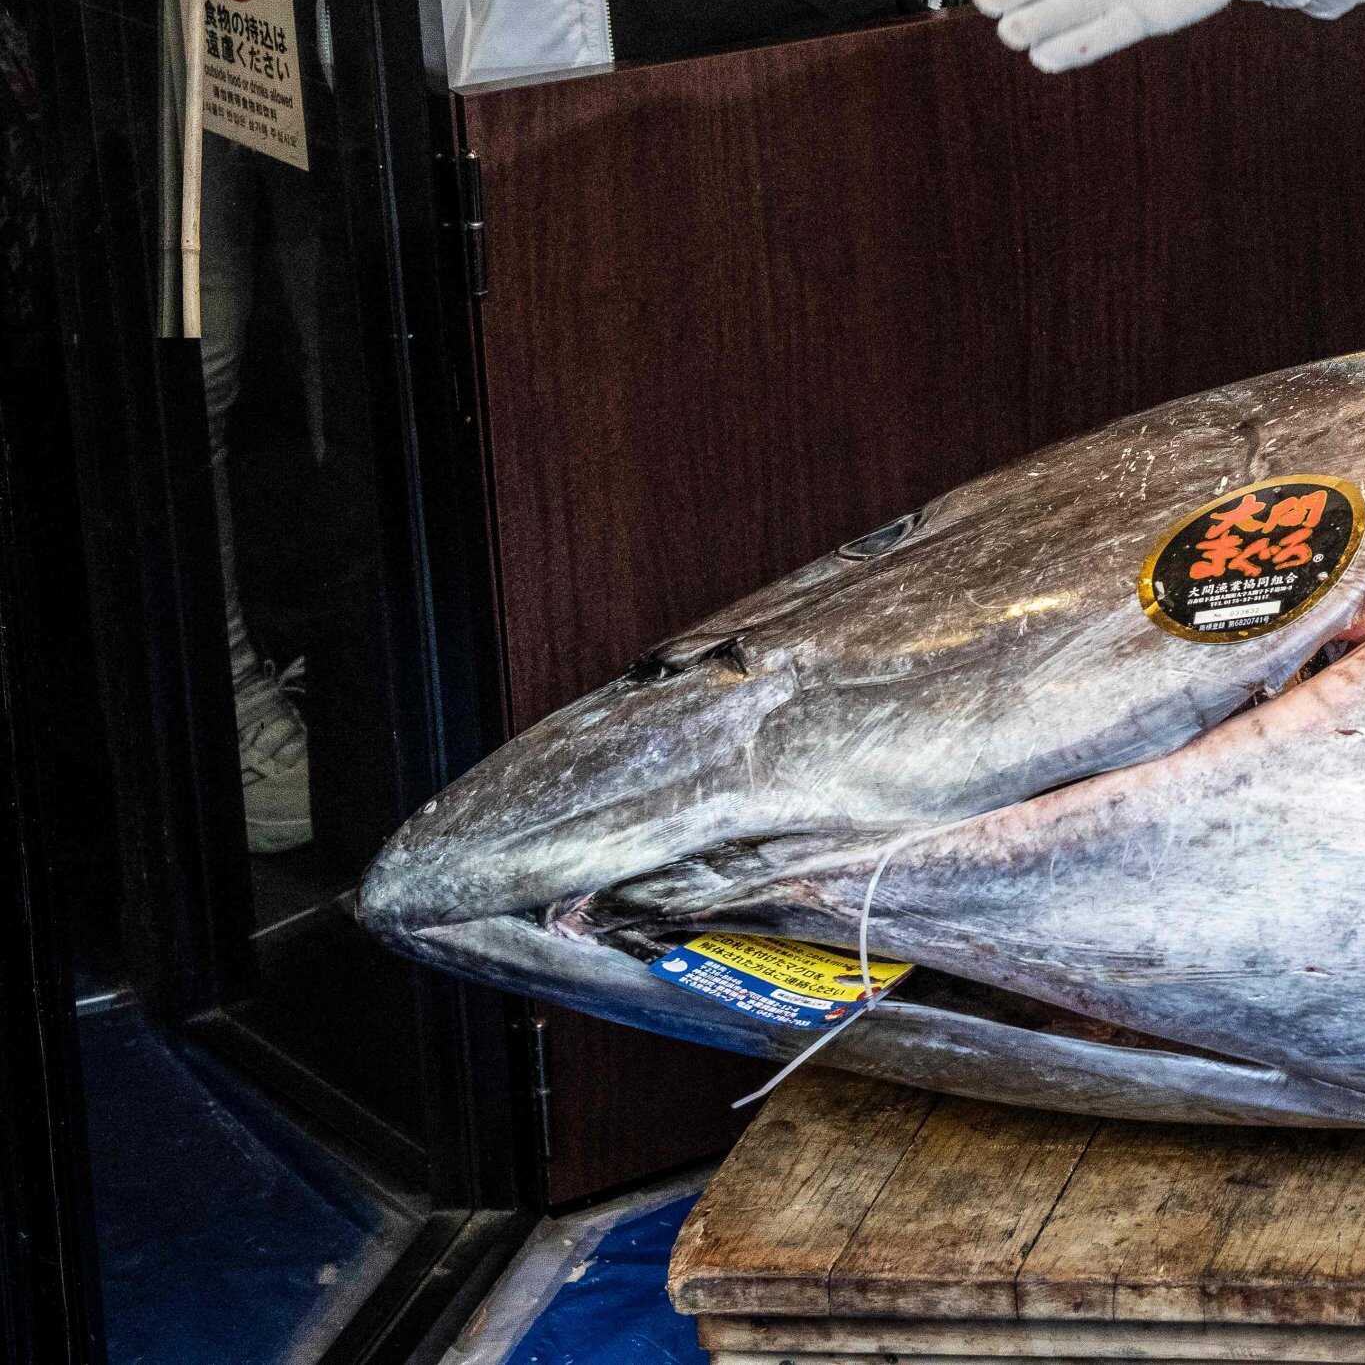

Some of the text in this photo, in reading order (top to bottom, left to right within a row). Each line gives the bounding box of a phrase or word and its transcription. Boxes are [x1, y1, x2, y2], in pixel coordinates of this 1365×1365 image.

[1205, 490, 1328, 539] 大間
[1189, 528, 1313, 580] まぐろ
[1187, 572, 1298, 598] 大間漁業協同組合
